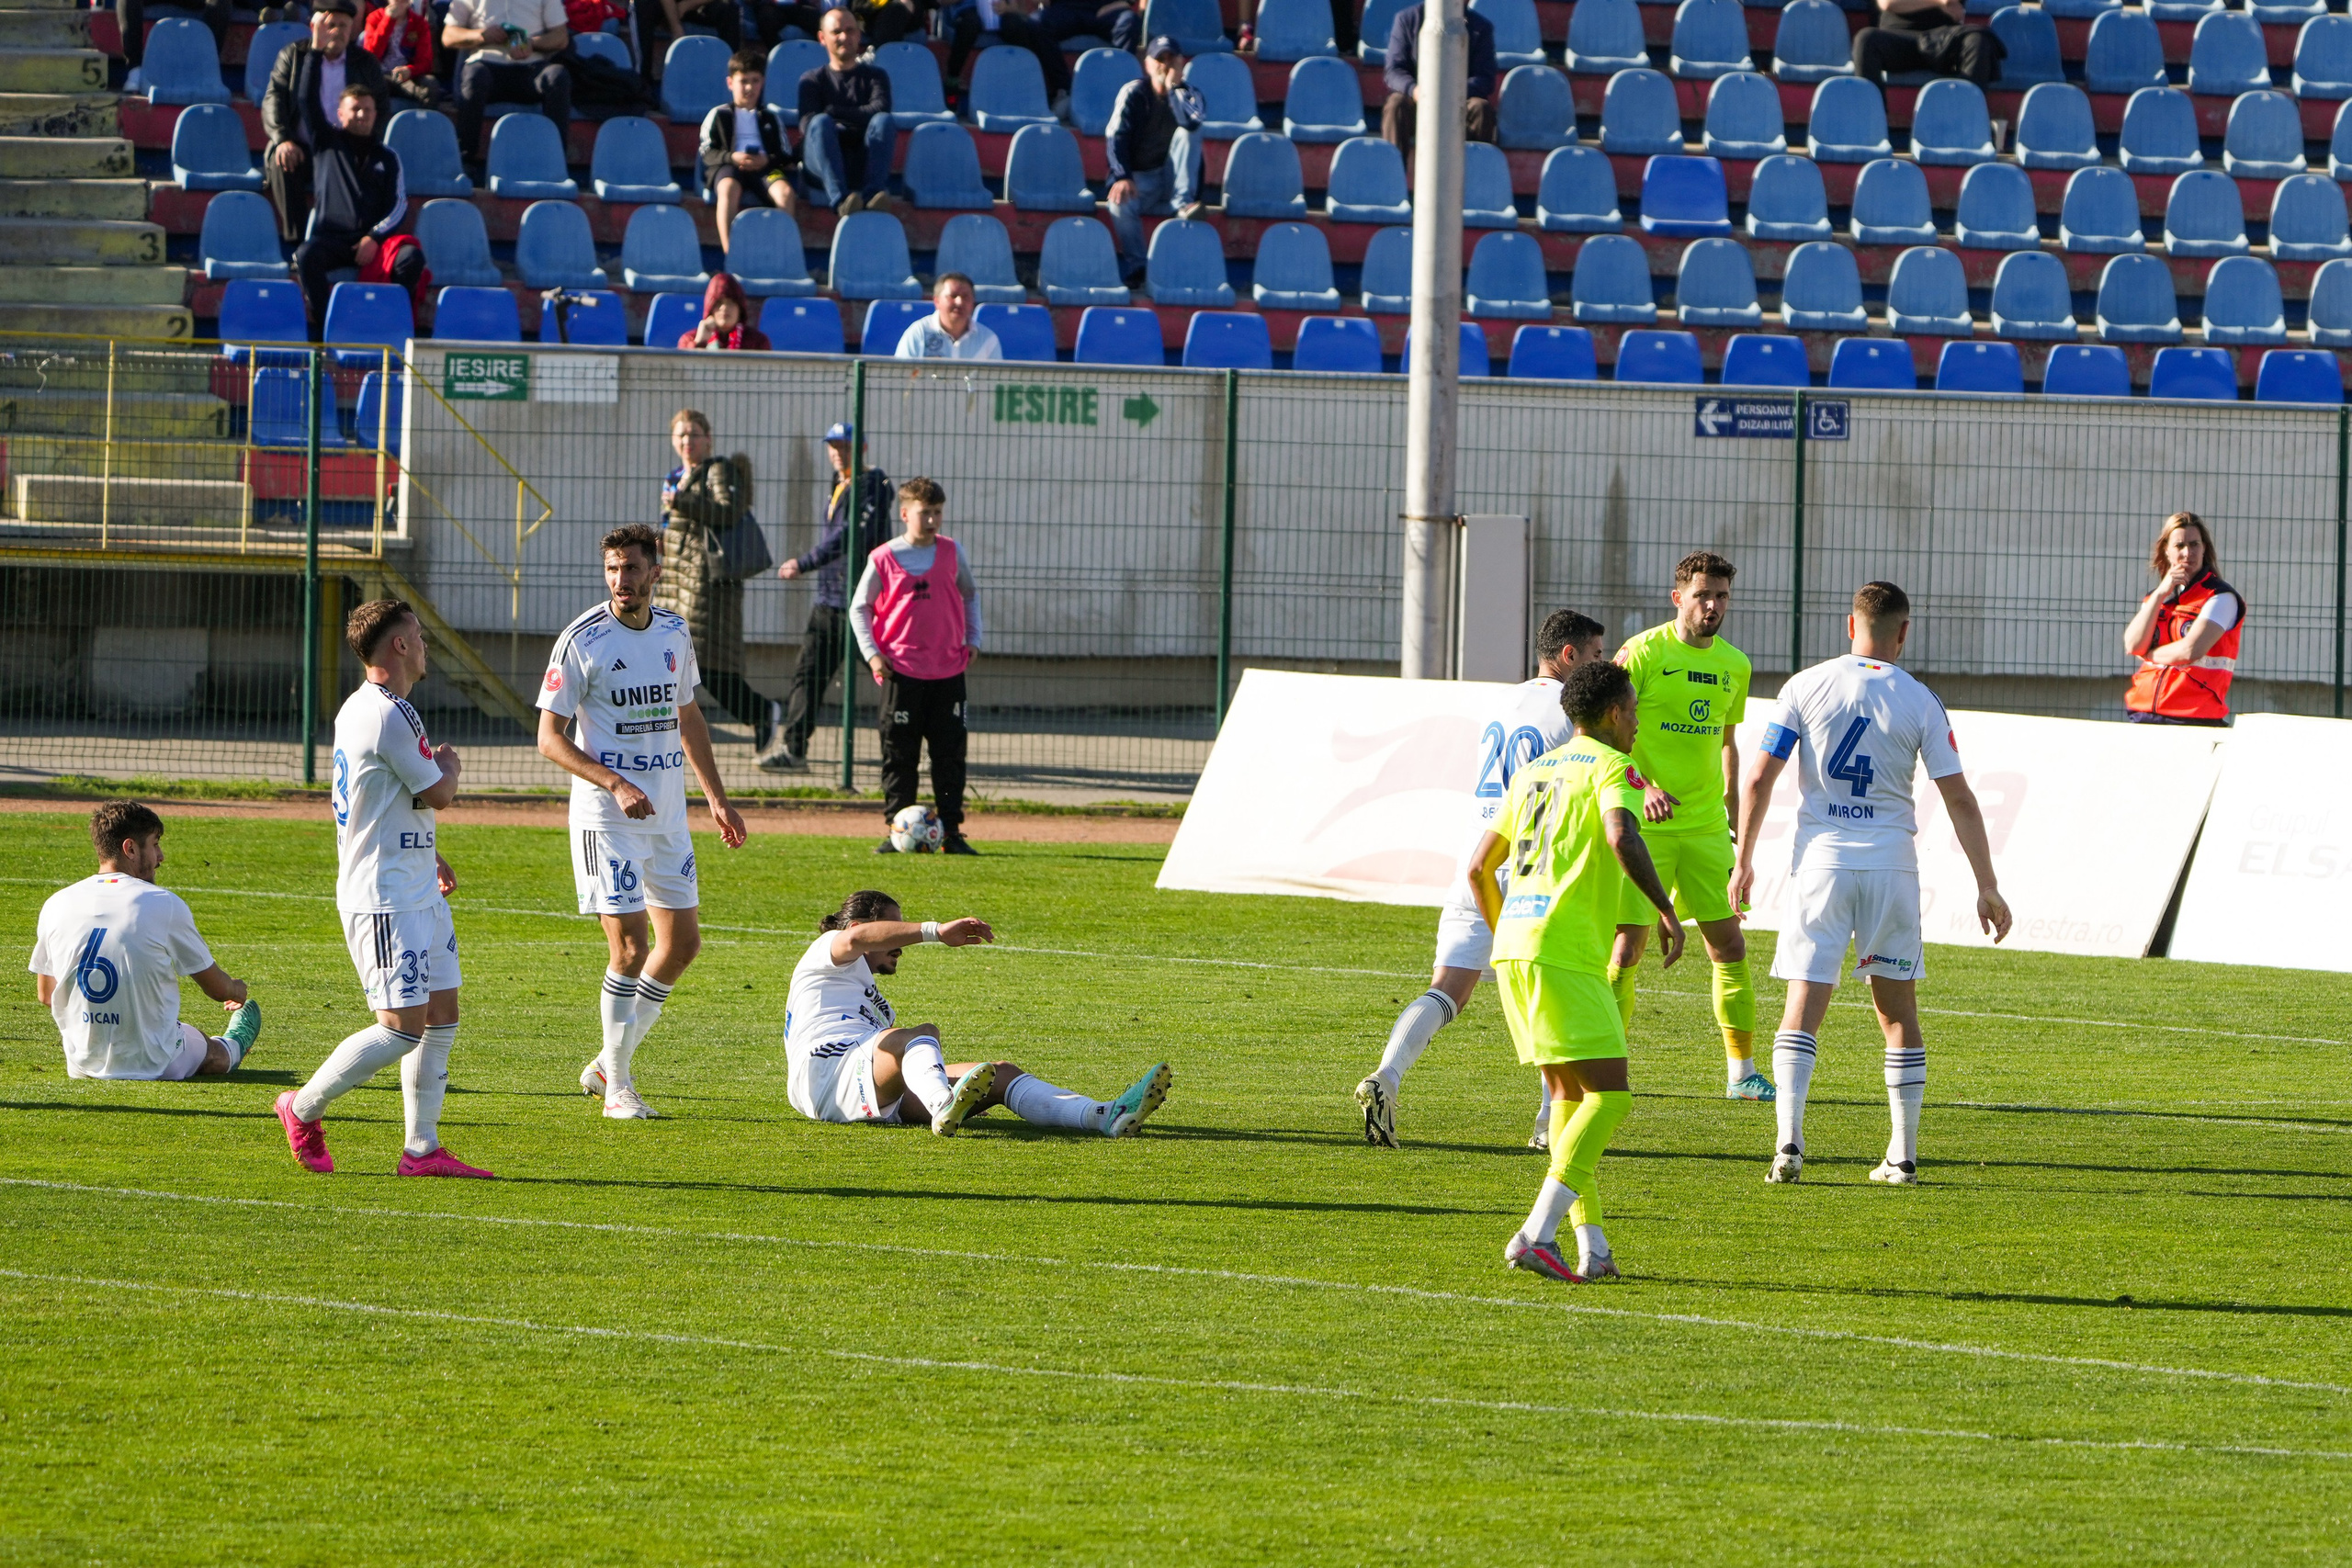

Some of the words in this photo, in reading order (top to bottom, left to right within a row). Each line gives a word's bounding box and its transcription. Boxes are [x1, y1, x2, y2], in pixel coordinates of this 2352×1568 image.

[83, 58, 102, 85] 5
[140, 232, 160, 262] 3
[166, 317, 189, 347] 2
[449, 358, 524, 378] IESIRE
[994, 384, 1099, 425] IESIRE
[1736, 404, 1790, 415] PERSOANE
[1687, 671, 1718, 685] IASI
[894, 710, 910, 725] CS
[1660, 721, 1712, 735] MOZZART
[600, 750, 683, 772] ELSACO
[1475, 721, 1544, 798] 20
[1827, 716, 1875, 798] 4
[1827, 804, 1874, 819] MIRON
[2249, 804, 2331, 840] Grupul
[400, 831, 435, 850] ELS
[610, 860, 637, 892] 16
[76, 928, 119, 1004] 6
[401, 950, 430, 984] 33
[1871, 954, 1897, 965] Smart
[1897, 959, 1912, 967] Eco
[82, 1011, 120, 1025] DICAN
